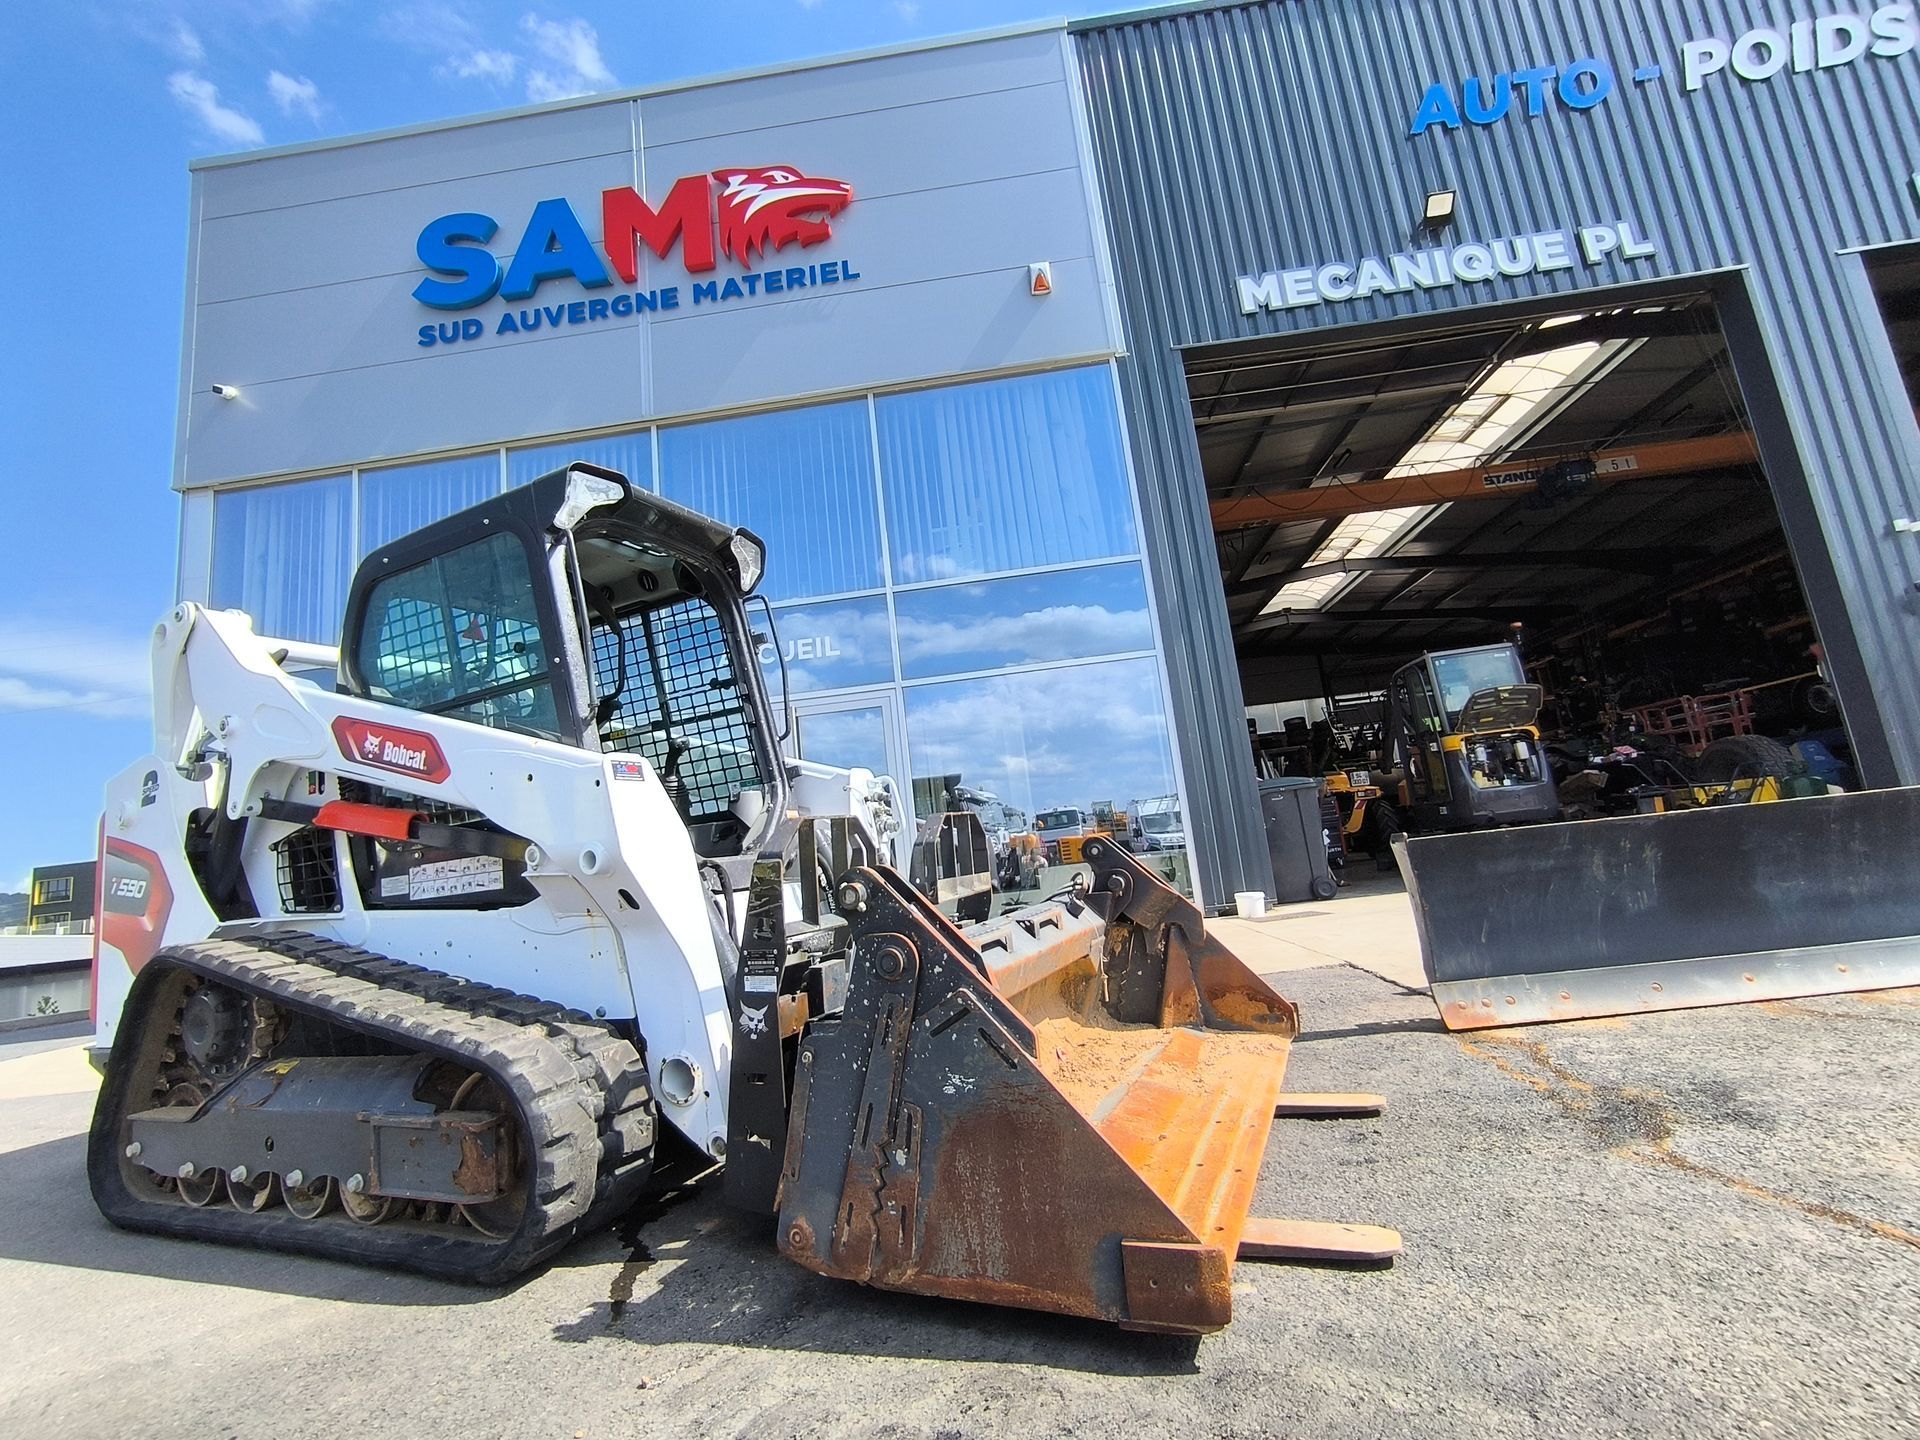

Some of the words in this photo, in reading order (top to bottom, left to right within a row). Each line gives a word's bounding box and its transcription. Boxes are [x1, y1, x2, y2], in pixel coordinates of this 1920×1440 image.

[1410, 58, 1613, 135] AUTO
[1683, 4, 1916, 91] POIDS
[411, 174, 716, 311] SAM
[1236, 229, 1574, 315] MECANIQUE
[1579, 221, 1658, 264] PL
[417, 318, 484, 348] SUD
[496, 287, 680, 336] AUVERGNE
[693, 260, 861, 305] MATERIEL
[1483, 471, 1537, 486] STAND
[717, 636, 841, 666] CUEIL
[382, 741, 427, 771] Bobcat
